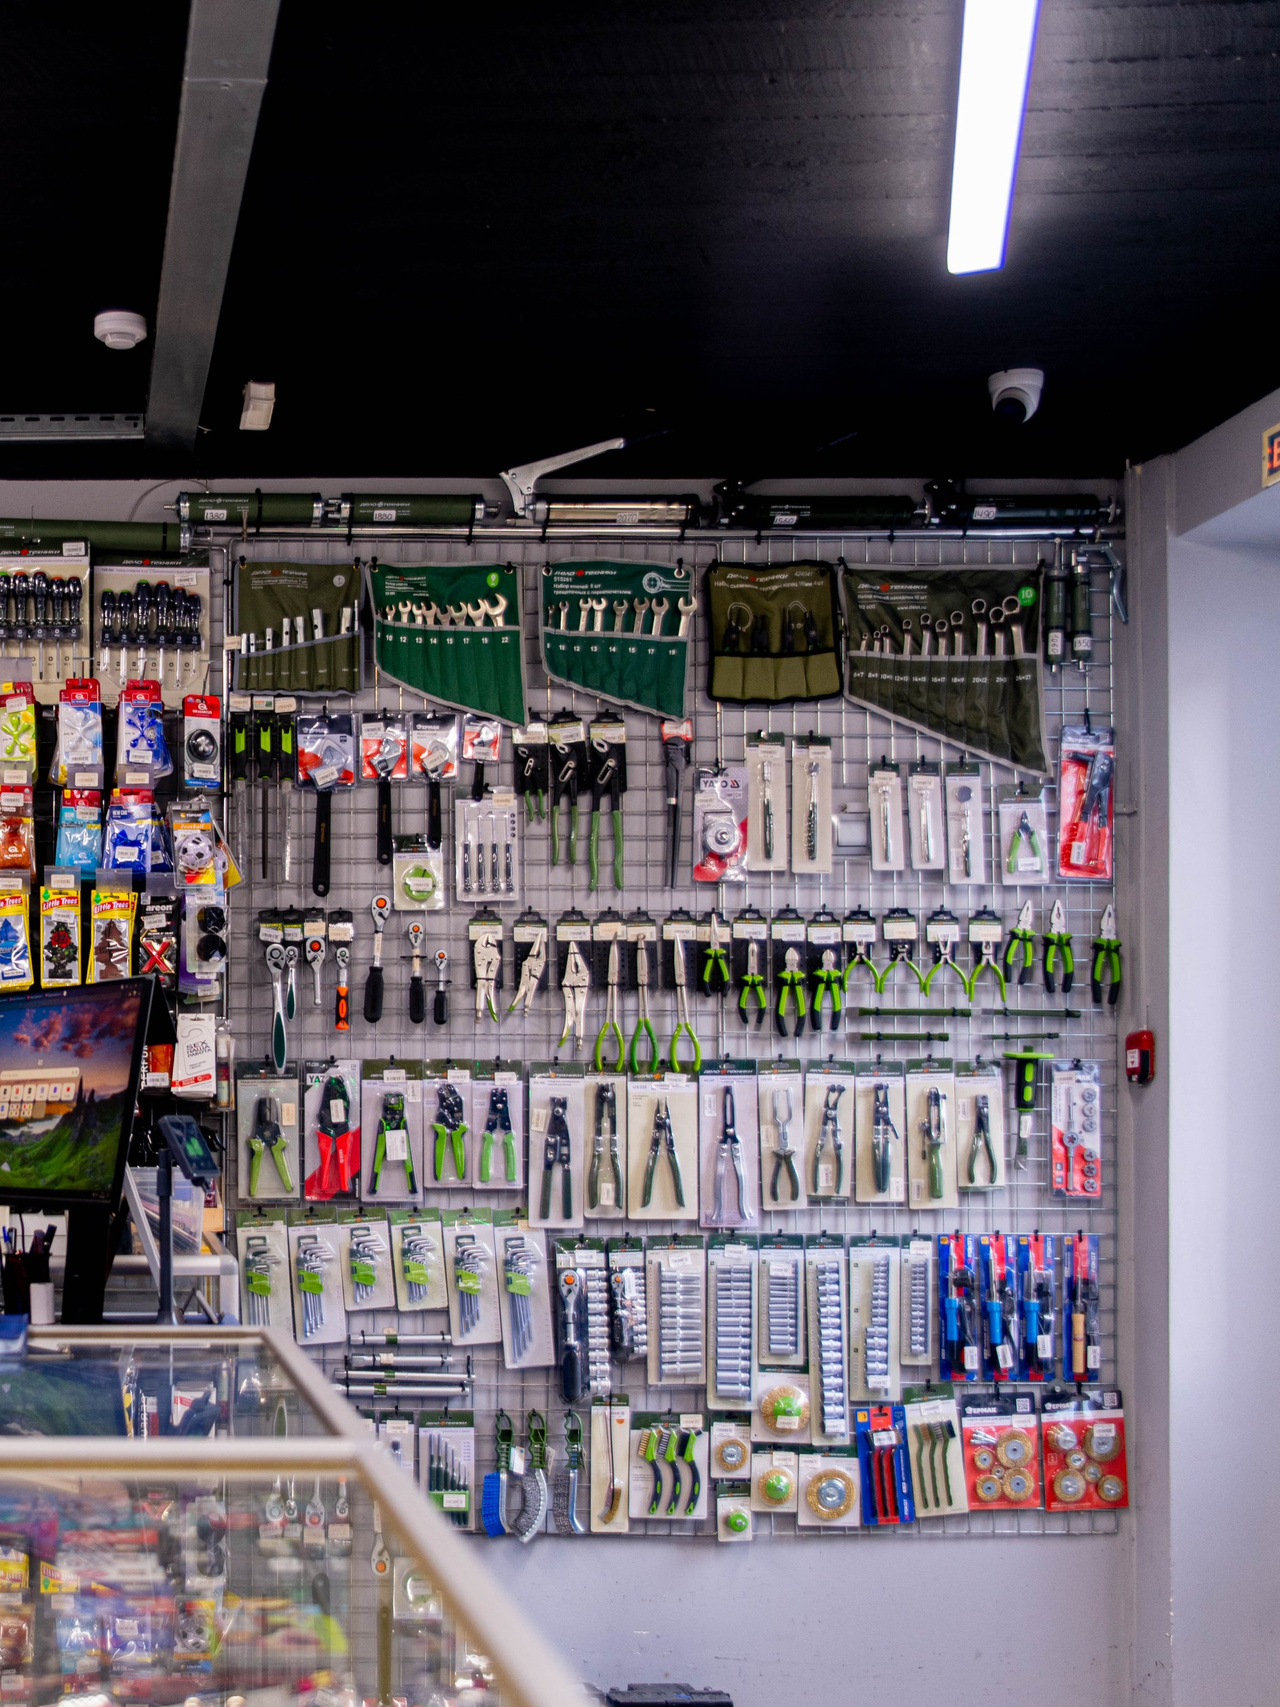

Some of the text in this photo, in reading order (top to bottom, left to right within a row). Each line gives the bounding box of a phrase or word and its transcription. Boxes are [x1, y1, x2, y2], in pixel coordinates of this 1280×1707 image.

[205, 511, 225, 520] 1380
[973, 509, 995, 518] 1490
[1021, 589, 1033, 598] 10
[430, 637, 438, 645] 14
[501, 636, 509, 644] 22
[5, 897, 22, 906] Trees
[42, 900, 60, 911] Little
[93, 904, 111, 914] Little
